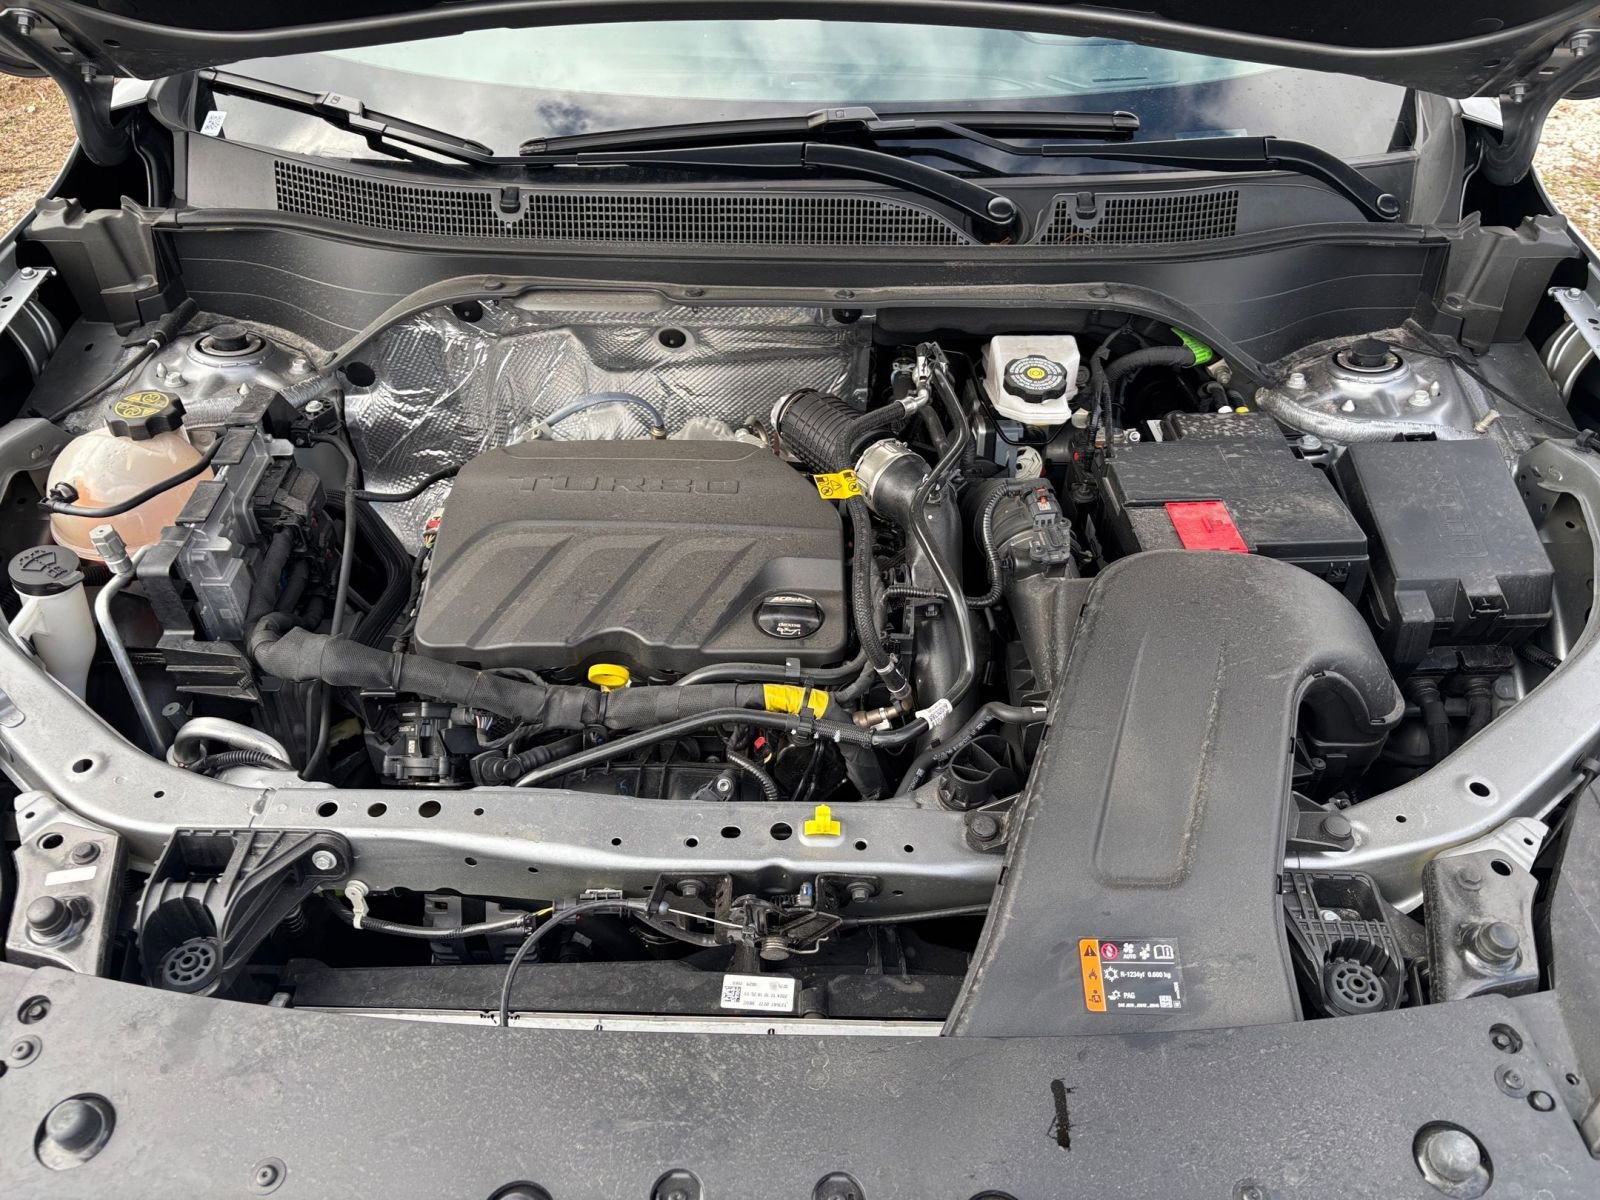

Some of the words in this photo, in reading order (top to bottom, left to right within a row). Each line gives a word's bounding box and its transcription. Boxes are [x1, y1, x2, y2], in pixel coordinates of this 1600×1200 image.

[508, 476, 740, 495] TURBO
[1120, 971, 1145, 979] R-1234yf
[1164, 971, 1171, 979] kg
